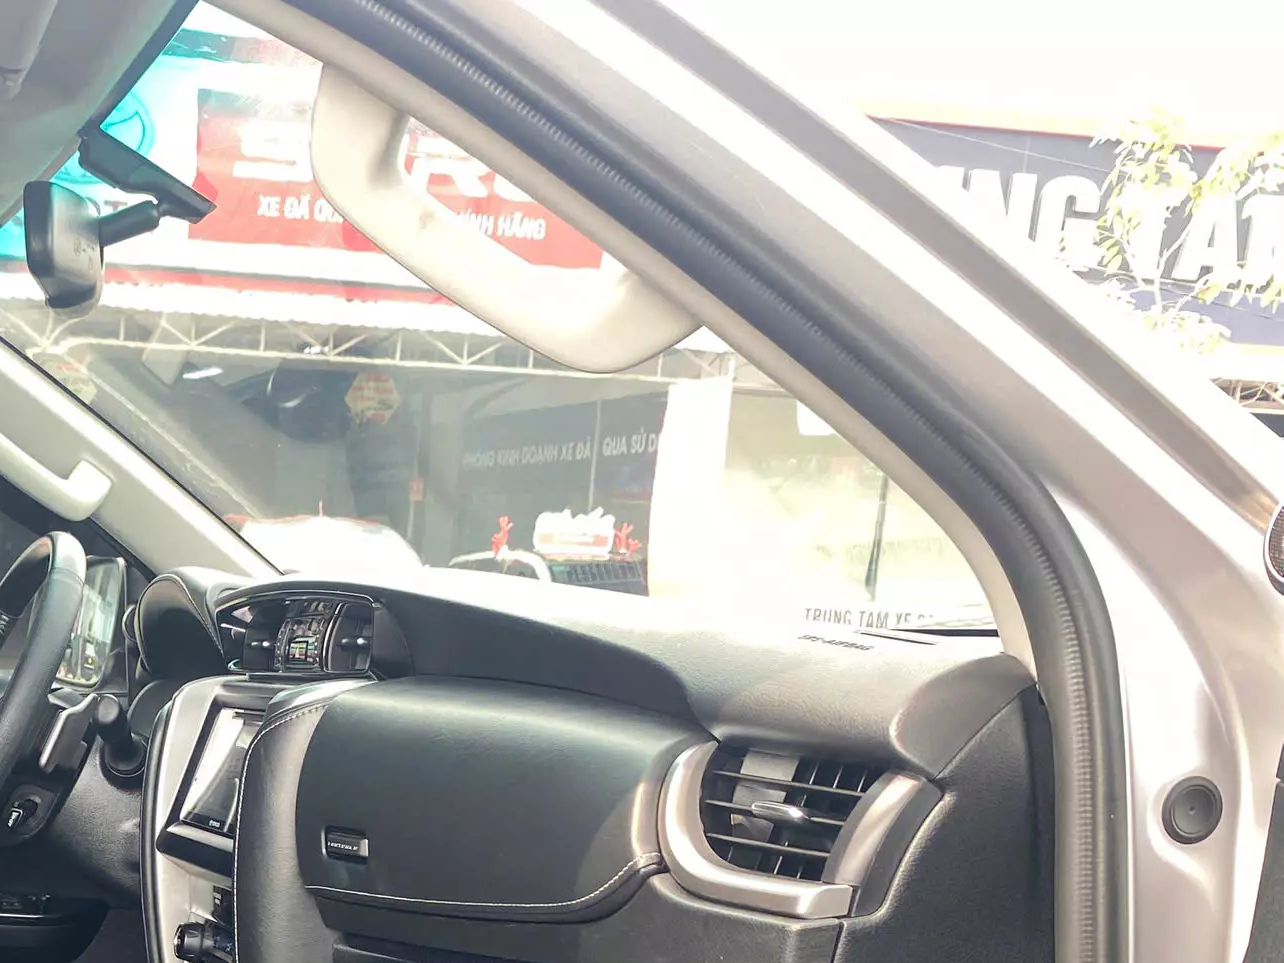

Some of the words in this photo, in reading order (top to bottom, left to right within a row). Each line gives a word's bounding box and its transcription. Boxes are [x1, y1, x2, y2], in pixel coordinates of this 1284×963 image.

[257, 195, 281, 217] XE
[561, 442, 574, 460] XE
[602, 436, 627, 457] QUA
